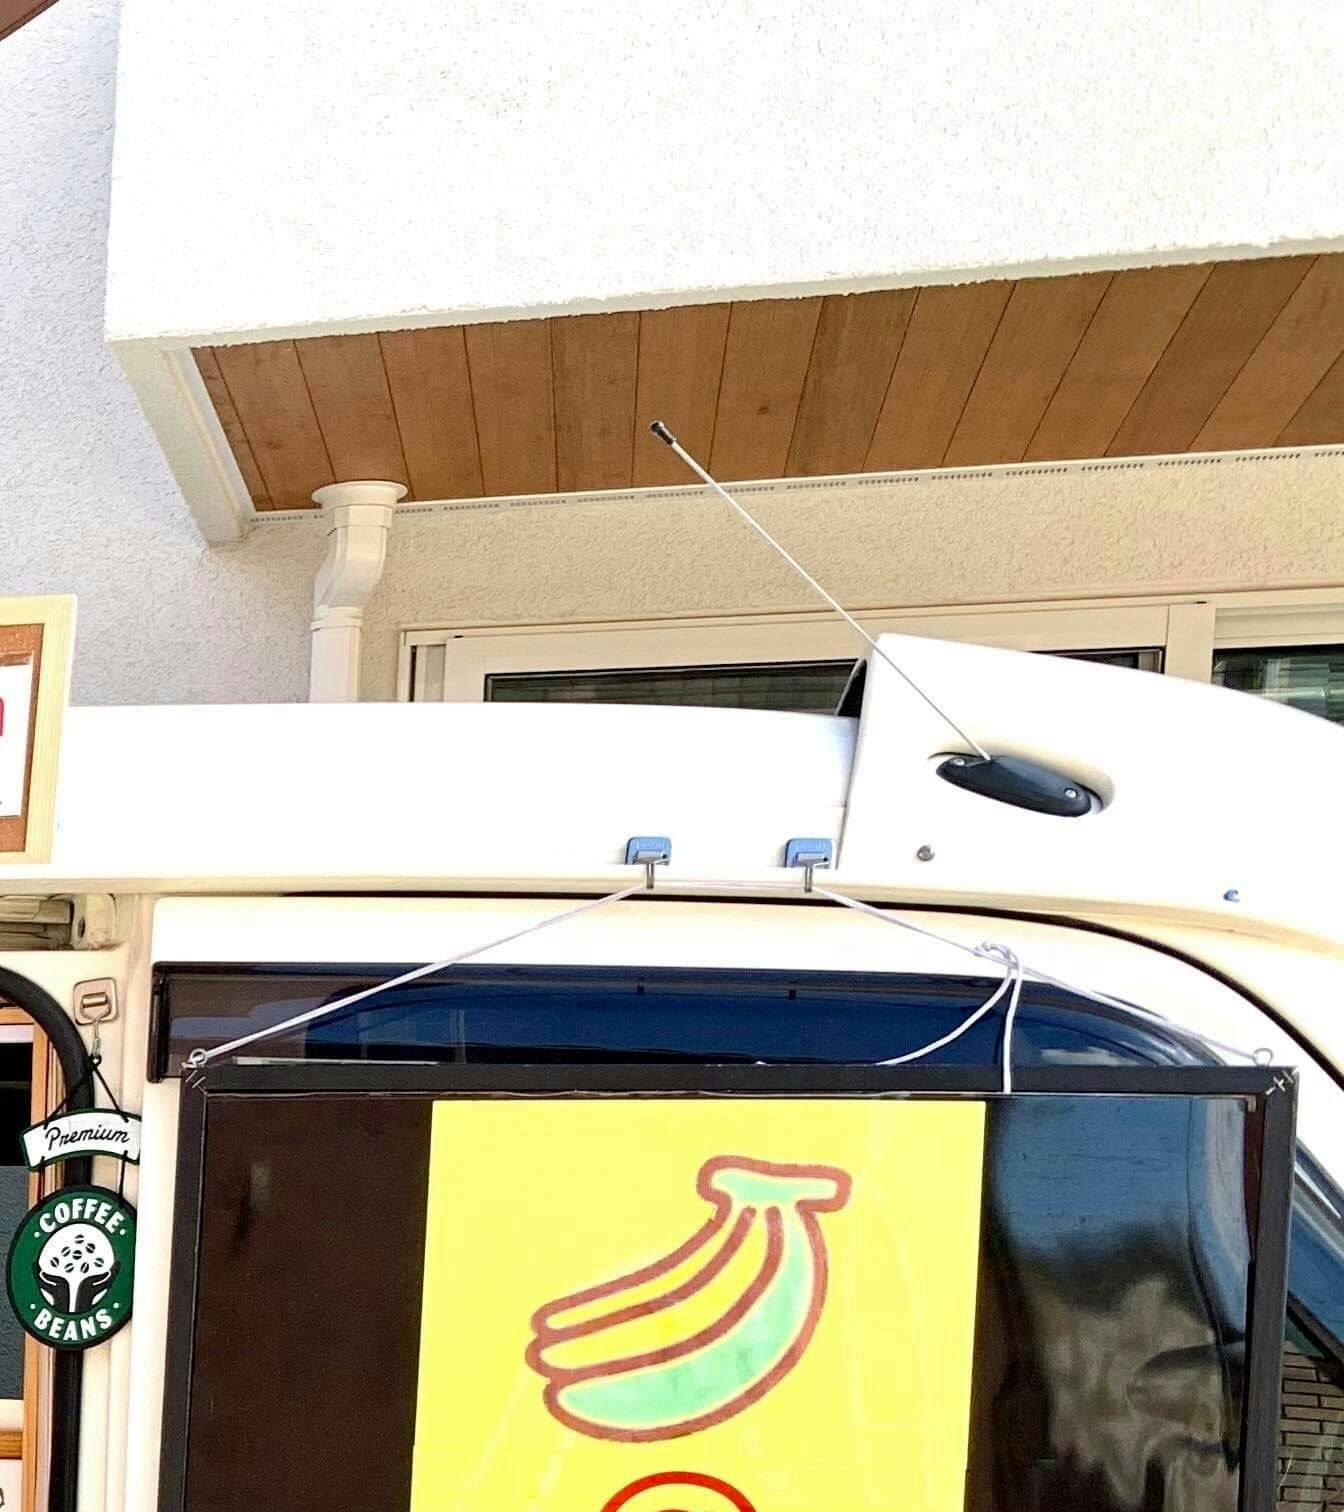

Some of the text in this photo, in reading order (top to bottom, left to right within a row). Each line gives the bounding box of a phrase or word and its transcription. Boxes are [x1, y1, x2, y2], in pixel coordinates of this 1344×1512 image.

[45, 1124, 130, 1151] Premium
[39, 1198, 124, 1233] COFFEE
[34, 1308, 113, 1341] BEANS
